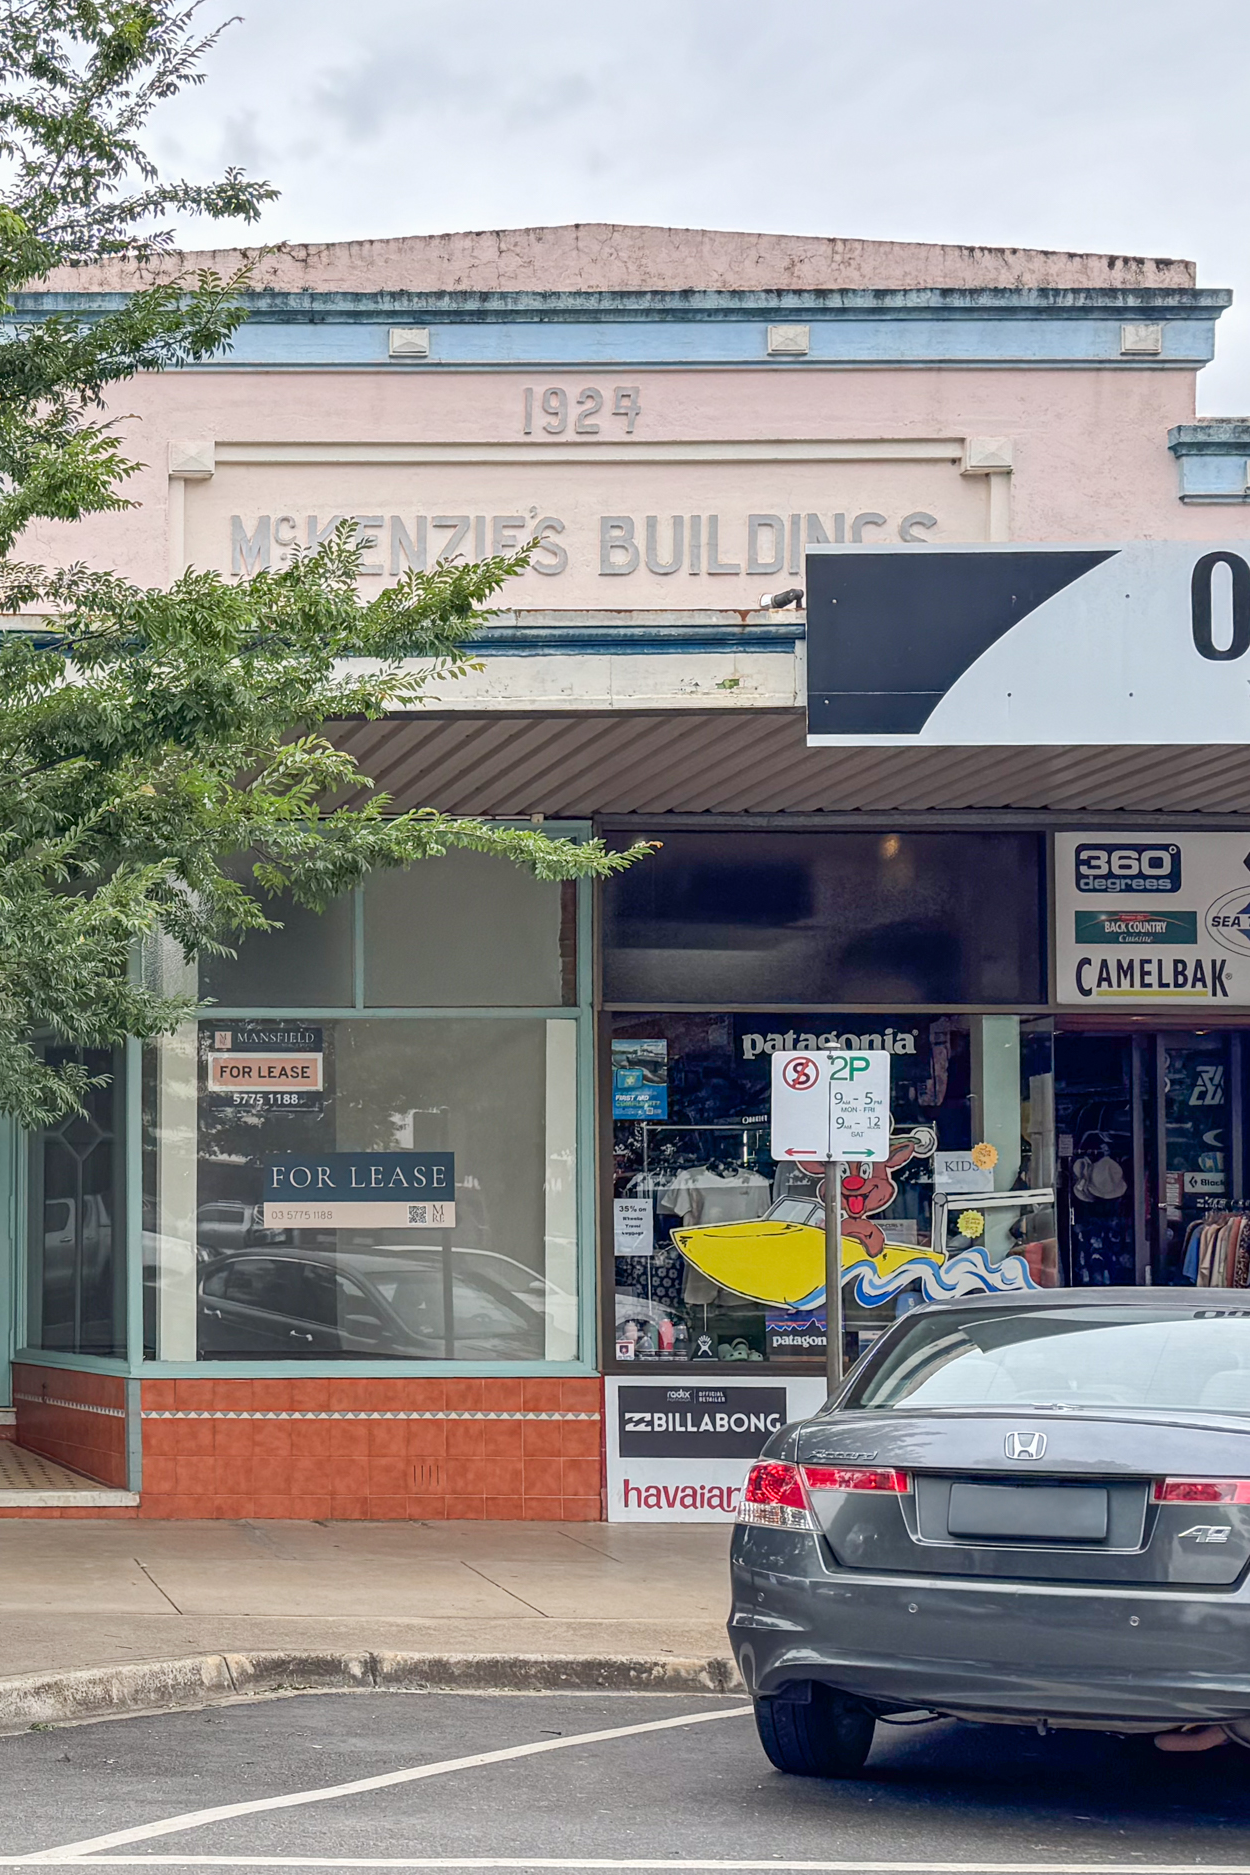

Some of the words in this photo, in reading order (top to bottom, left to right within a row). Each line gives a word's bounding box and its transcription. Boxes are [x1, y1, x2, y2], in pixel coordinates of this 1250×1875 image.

[1079, 875, 1172, 892] degrees
[1104, 921, 1127, 933] BACK
[1128, 921, 1167, 933] COUNTRY
[1211, 915, 1242, 928] SEA
[1118, 933, 1155, 943] Cuisine
[237, 1032, 315, 1043] MANSFIELD
[220, 1066, 252, 1079] FOR
[258, 1066, 311, 1079] LEASE
[830, 1056, 871, 1081] 2P
[233, 1093, 263, 1105] 5775
[268, 1093, 298, 1105] 1188
[944, 1160, 980, 1173] KIDS
[271, 1166, 337, 1188] FOR
[350, 1166, 447, 1188] LEASE
[271, 1210, 284, 1220] 03
[287, 1210, 311, 1220] 5775
[313, 1210, 333, 1220] 1188
[619, 1205, 638, 1213] 35%
[653, 1412, 781, 1433] BILLABONG
